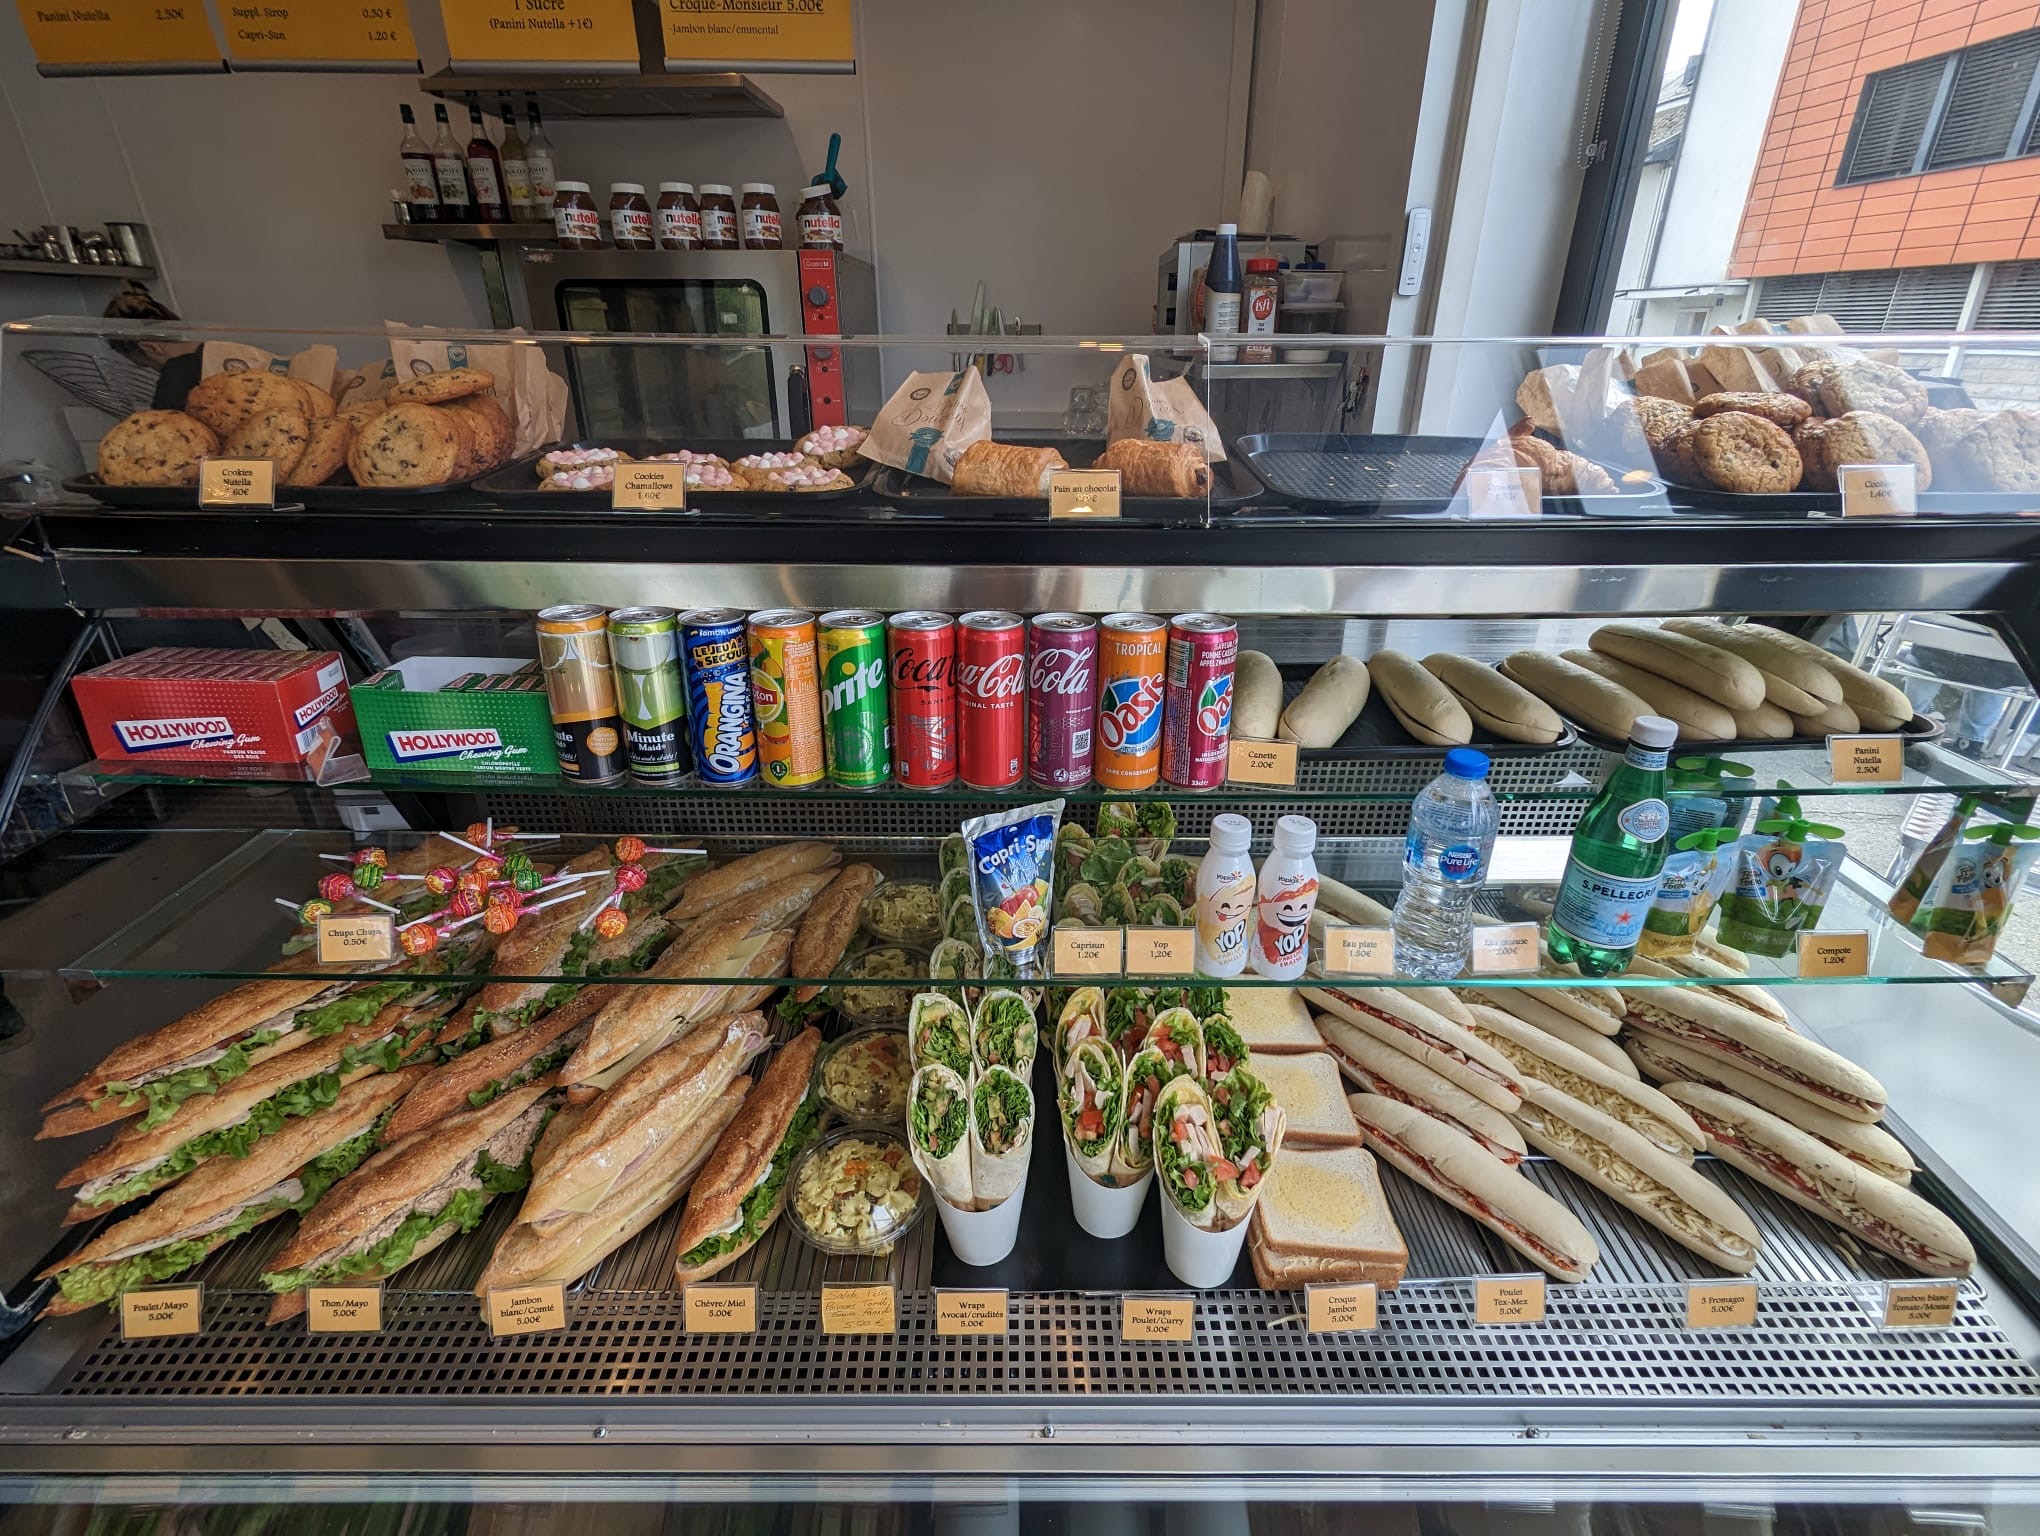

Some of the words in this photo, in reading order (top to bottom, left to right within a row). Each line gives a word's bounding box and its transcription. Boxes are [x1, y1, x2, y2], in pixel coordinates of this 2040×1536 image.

[37, 10, 71, 22] Panini
[72, 10, 112, 22] Nutella
[263, 7, 289, 19] Sirop
[489, 18, 526, 30] (Panini
[528, 18, 566, 29] Nutella
[238, 30, 287, 42] Capri-Sun
[368, 31, 387, 41] 1.20
[804, 217, 841, 229] nutella
[221, 468, 253, 477] Cookies
[634, 472, 664, 480] Cookies
[223, 478, 252, 486] Nutella
[625, 481, 672, 490] Chamallows
[1053, 485, 1071, 493] Pain
[1084, 484, 1117, 493] chocolat
[694, 647, 707, 658] LE
[707, 643, 729, 654] JEU
[1115, 641, 1161, 657] TROPICAL
[1201, 650, 1222, 660] POMME
[821, 657, 884, 726] prite
[299, 687, 338, 720] HOLLYWOOD
[990, 701, 1015, 709] TASTE
[1099, 673, 1164, 750] Oasis
[708, 671, 747, 774] ORANGINA
[125, 721, 226, 742] HOLLYWOOD
[626, 729, 675, 743] Minute
[190, 738, 236, 751] Chewing
[236, 733, 261, 745] Gum
[397, 732, 496, 752] HOLLYWOOD
[638, 742, 661, 752] Maid
[459, 747, 504, 761] Chewing
[504, 744, 528, 756] Gum
[1248, 750, 1277, 760] Canette
[1854, 746, 1880, 755] Panini
[1250, 760, 1274, 769] 2.00€
[1853, 756, 1882, 764] Nutella
[1856, 766, 1881, 775] 2.50€
[977, 834, 1053, 875] Capri-Sun
[1439, 855, 1463, 866] Pure
[1463, 857, 1479, 869] Life
[328, 929, 353, 939] Chupa
[1214, 919, 1246, 953] YOP
[343, 938, 367, 946] 0.50€
[1152, 940, 1168, 951] Yop
[1273, 924, 1307, 957] YOP
[1342, 939, 1357, 948] Eau
[1358, 940, 1378, 951] plate
[1070, 941, 1105, 951] Caprisun
[1077, 950, 1099, 958] 1.20€
[1349, 949, 1372, 958] 1.50€
[1817, 946, 1852, 957] Compote
[1823, 956, 1846, 965] 1.20€
[1499, 1288, 1523, 1297] Poulet
[510, 1296, 543, 1308] Jambon
[1327, 1295, 1356, 1306] Croque
[1493, 1298, 1528, 1306] Tex-Mex
[1708, 1295, 1745, 1306] Fromages
[1896, 1295, 1925, 1303] Jambon
[1927, 1294, 1949, 1302] blanc
[133, 1301, 189, 1313] Poulet/Mayo
[320, 1299, 369, 1309] Thon/Mayo
[694, 1299, 746, 1309] Chèvre/Miel
[958, 1301, 985, 1311] Wraps
[1711, 1304, 1735, 1313] 5.00€
[333, 1308, 357, 1317] 5.00€
[501, 1304, 555, 1317] blanc/Comté
[708, 1309, 733, 1318] 5.00€
[940, 1310, 1004, 1320] Avocat/crudités
[1145, 1307, 1171, 1317] Wraps
[1327, 1305, 1357, 1316] Jambon
[1499, 1307, 1523, 1316] 5.00€
[148, 1311, 174, 1321] 5.00€
[516, 1315, 541, 1326] 5.00€
[1330, 1314, 1354, 1324] 5.00€
[960, 1319, 984, 1328] 5.00€
[1131, 1316, 1184, 1327] Poulet/Curry
[1145, 1325, 1169, 1334] 5.00€
